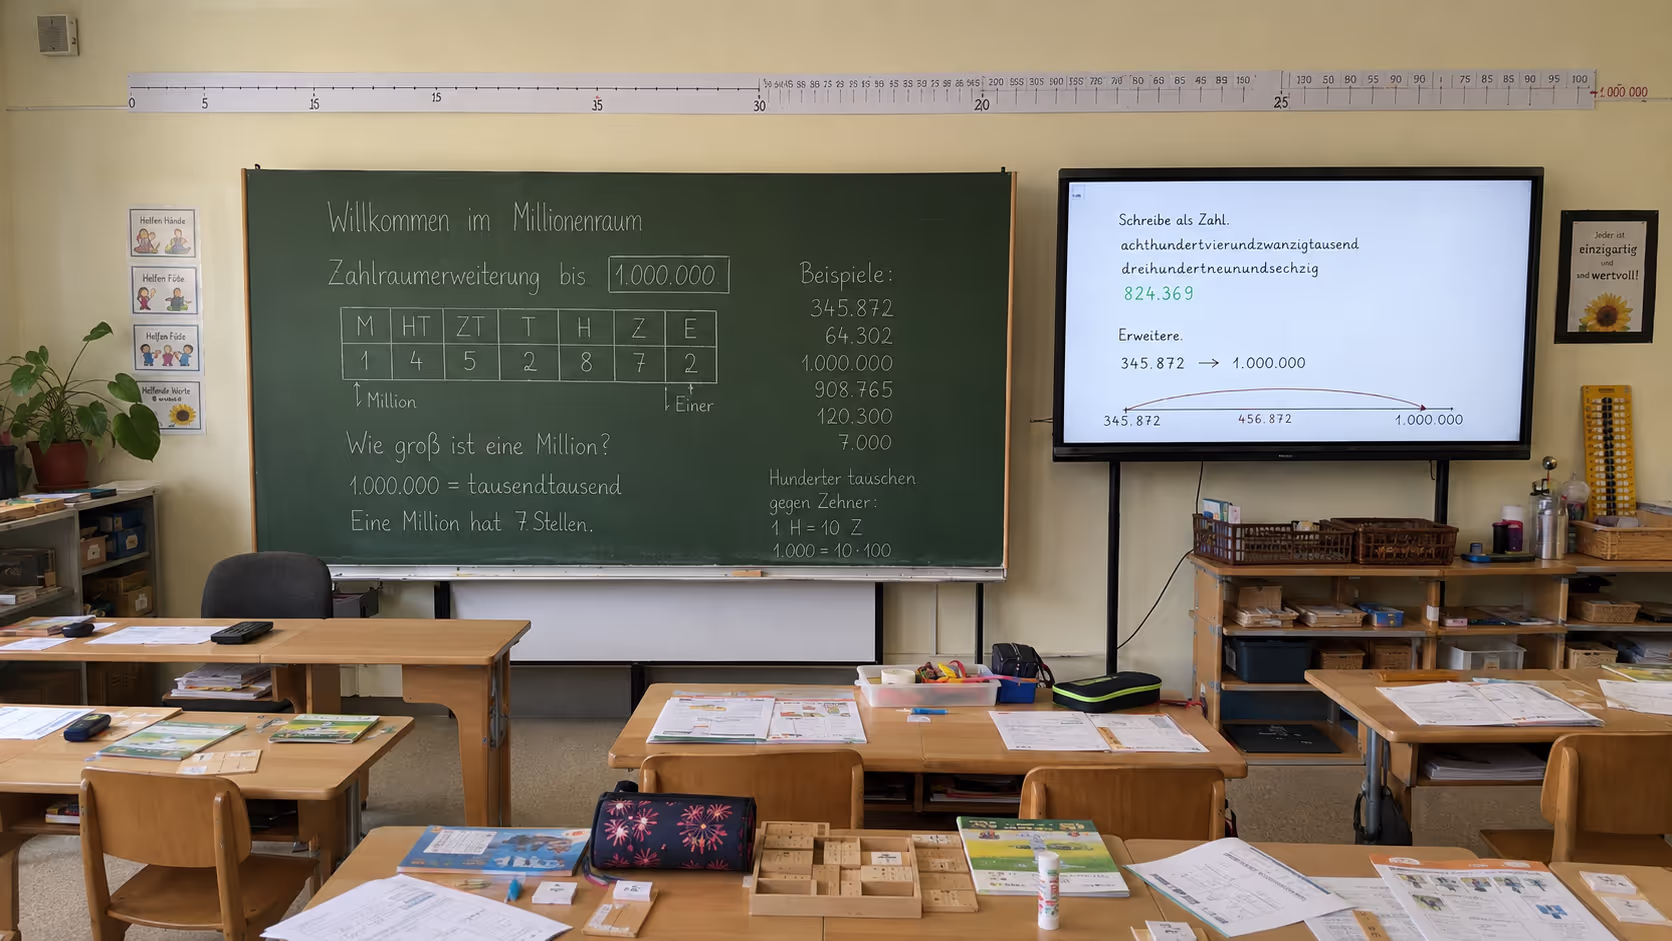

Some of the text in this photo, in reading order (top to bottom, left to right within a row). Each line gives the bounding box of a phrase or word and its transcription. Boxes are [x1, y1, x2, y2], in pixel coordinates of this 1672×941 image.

[1548, 75, 1560, 83] 95
[1572, 75, 1588, 83] 100
[128, 92, 1288, 112] 0 5 15 15 35 30 20 25
[327, 201, 643, 233] Willkommen im Millionenraum
[1118, 213, 1230, 227] Schreibe als Zahl.
[1594, 231, 1625, 239] Jeder ist
[1120, 237, 1360, 255] achthundertvierundzwanzigtausend
[1579, 244, 1638, 256] einzigartig
[327, 259, 716, 295] Zahlraumerweiterung bis 1.000.000
[1121, 261, 1320, 278] dreihundertneunundsechzig
[1591, 270, 1639, 281] wertvoll!
[1124, 286, 1194, 302] 824.369
[810, 298, 893, 317] 345.872
[356, 315, 697, 339] M HT ZT T H Z E
[825, 326, 893, 345] 64.302
[1118, 328, 1184, 343] Erweitere.
[360, 350, 698, 374] 1 4 5 2 8 7 2
[801, 354, 893, 372] 1.000.000
[1120, 356, 1306, 370] 345.872 1.000.000
[815, 380, 893, 398] 908.765
[367, 392, 417, 410] Million
[675, 395, 714, 413] Einer
[817, 408, 893, 425] 120.300
[1103, 413, 1464, 427] 345.872 456.872 1.000.000
[345, 431, 611, 464] Wie groß ist eine Million?
[839, 434, 892, 451] 7.000
[349, 473, 622, 495] 1.000.000 = tausendtausend
[769, 468, 916, 486] Hunderter tauschen
[769, 493, 877, 515] gegen Zehner:
[351, 509, 391, 532] Eine
[403, 510, 460, 532] Million
[470, 511, 502, 532] hat
[533, 510, 593, 533] Stellen.
[771, 519, 780, 536] 1
[790, 519, 801, 536] H
[821, 519, 840, 536] 10
[851, 518, 863, 536] Z
[773, 543, 815, 558] 1.000
[834, 543, 852, 558] 10
[863, 542, 891, 558] 100
